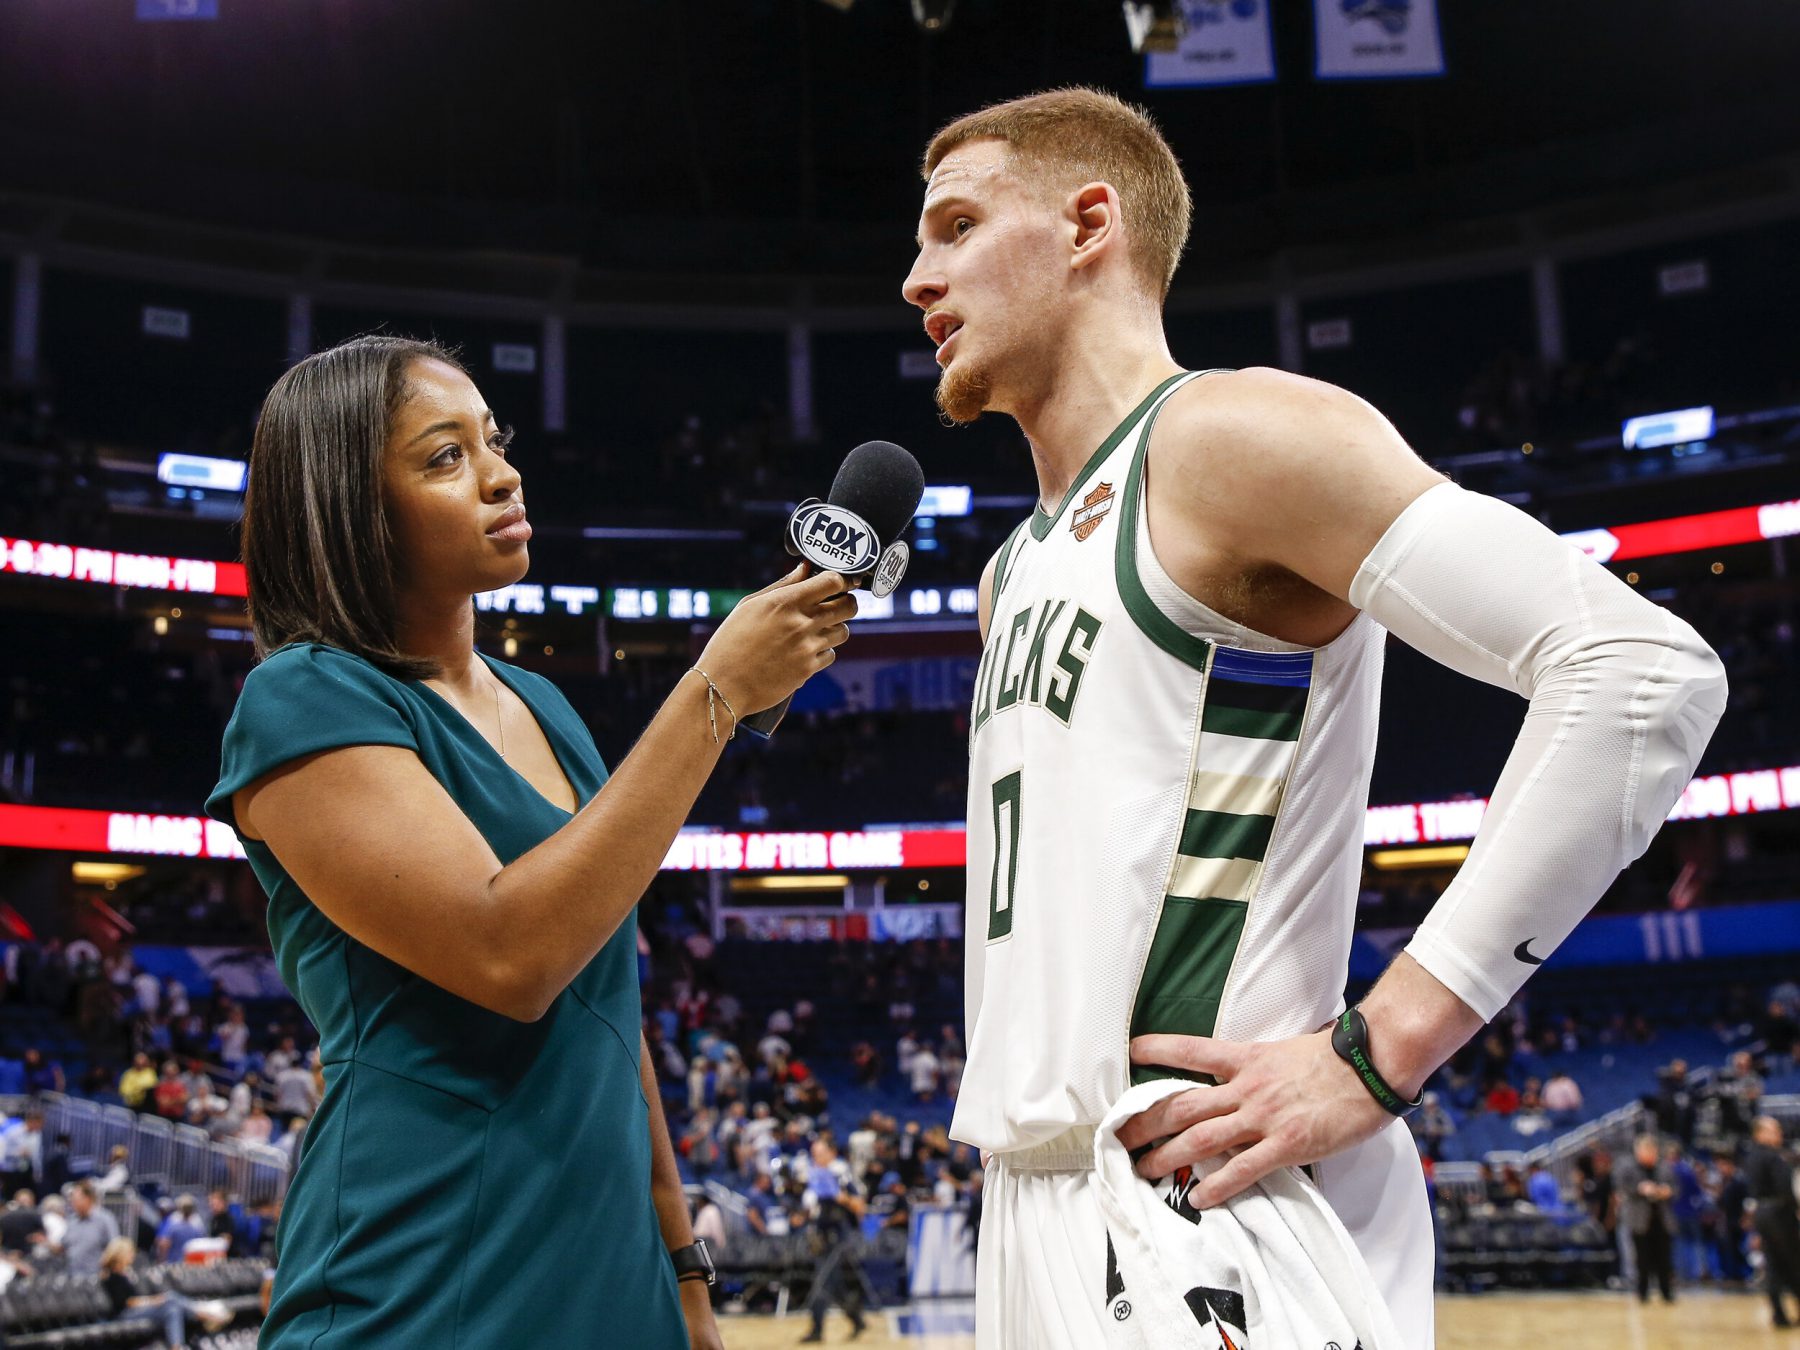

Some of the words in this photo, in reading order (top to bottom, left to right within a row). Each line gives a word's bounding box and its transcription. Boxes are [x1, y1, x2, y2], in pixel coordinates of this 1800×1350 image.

[804, 535, 856, 565] SPORTS
[809, 512, 866, 556] FOX
[883, 551, 904, 580] FOX
[974, 599, 1105, 729] UCKS
[986, 766, 1023, 946] 0
